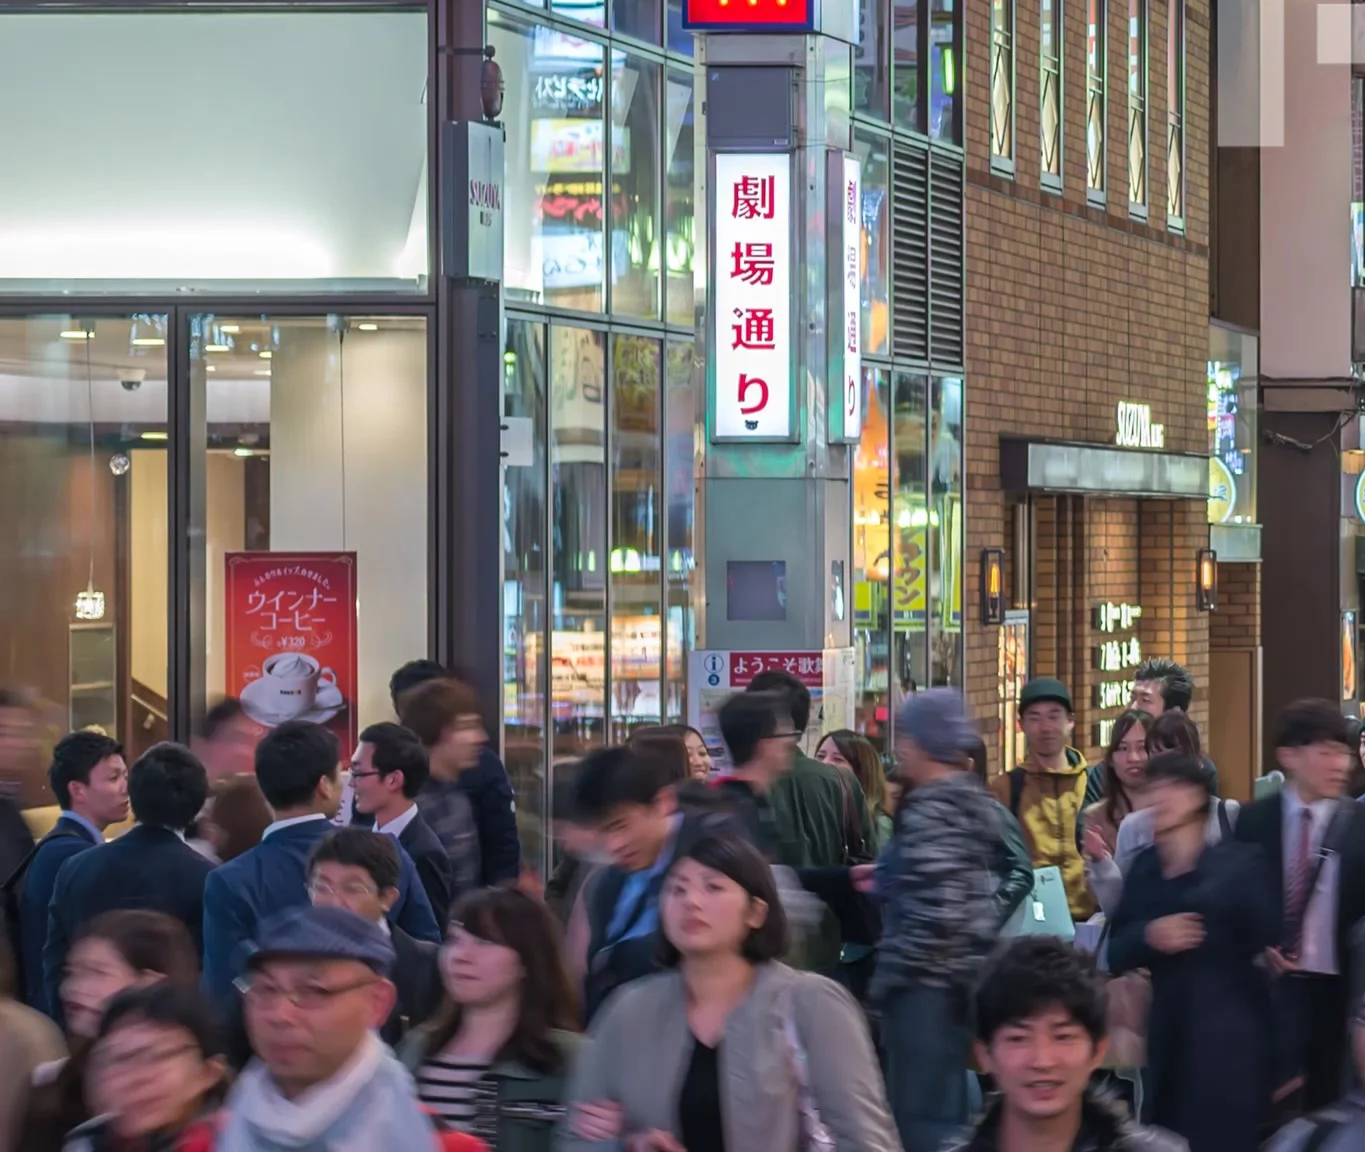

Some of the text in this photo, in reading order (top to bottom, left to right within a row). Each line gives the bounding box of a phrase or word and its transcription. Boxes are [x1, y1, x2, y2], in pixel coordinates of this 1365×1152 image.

[729, 175, 776, 416] 劇場通り
[246, 588, 338, 614] ウインナー
[260, 611, 326, 632] コーヒー
